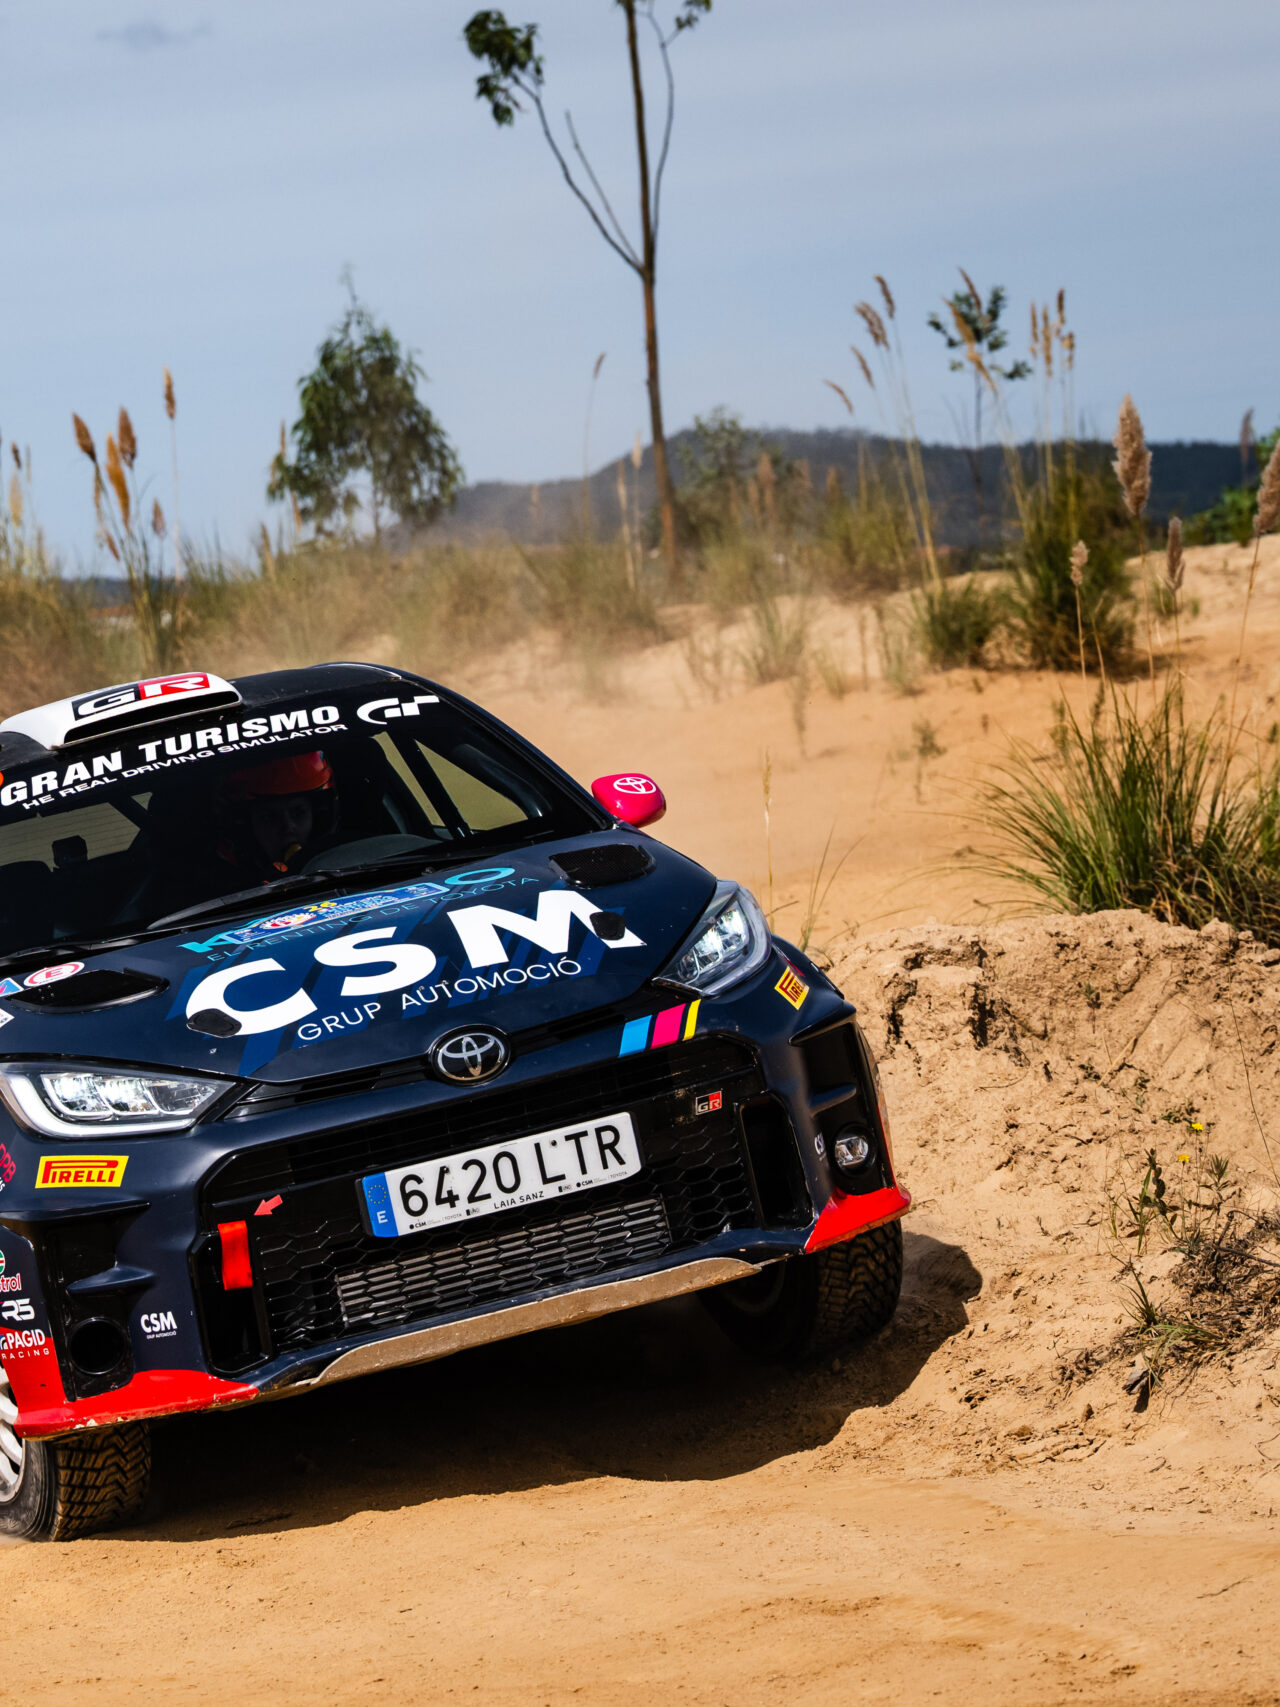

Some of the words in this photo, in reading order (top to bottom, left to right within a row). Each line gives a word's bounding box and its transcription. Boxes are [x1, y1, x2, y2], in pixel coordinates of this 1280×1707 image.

[77, 677, 206, 716] GR
[0, 750, 123, 807] GRAN
[138, 705, 340, 763] TURISMO
[59, 777, 118, 798] REAL
[121, 749, 215, 778] DRIVING
[219, 723, 349, 754] SIMULATOR
[206, 945, 242, 962] EL
[246, 914, 373, 950] RENTING
[379, 902, 420, 916] DE
[423, 877, 540, 905] TOYOTA
[186, 888, 648, 1037] CSM
[297, 1002, 382, 1041] GRUP
[401, 956, 582, 1011] AUTOMOCIÓ
[697, 1098, 721, 1113] GR
[41, 1160, 119, 1185] PIRELLI
[398, 1151, 522, 1217] 6420
[534, 1124, 627, 1186] LTR
[493, 1197, 517, 1210] LAIA
[519, 1190, 545, 1204] SANZ
[376, 1210, 389, 1224] E
[140, 1310, 178, 1334] CSM
[1, 1347, 50, 1360] RACING
[6, 1328, 46, 1350] PAGID
